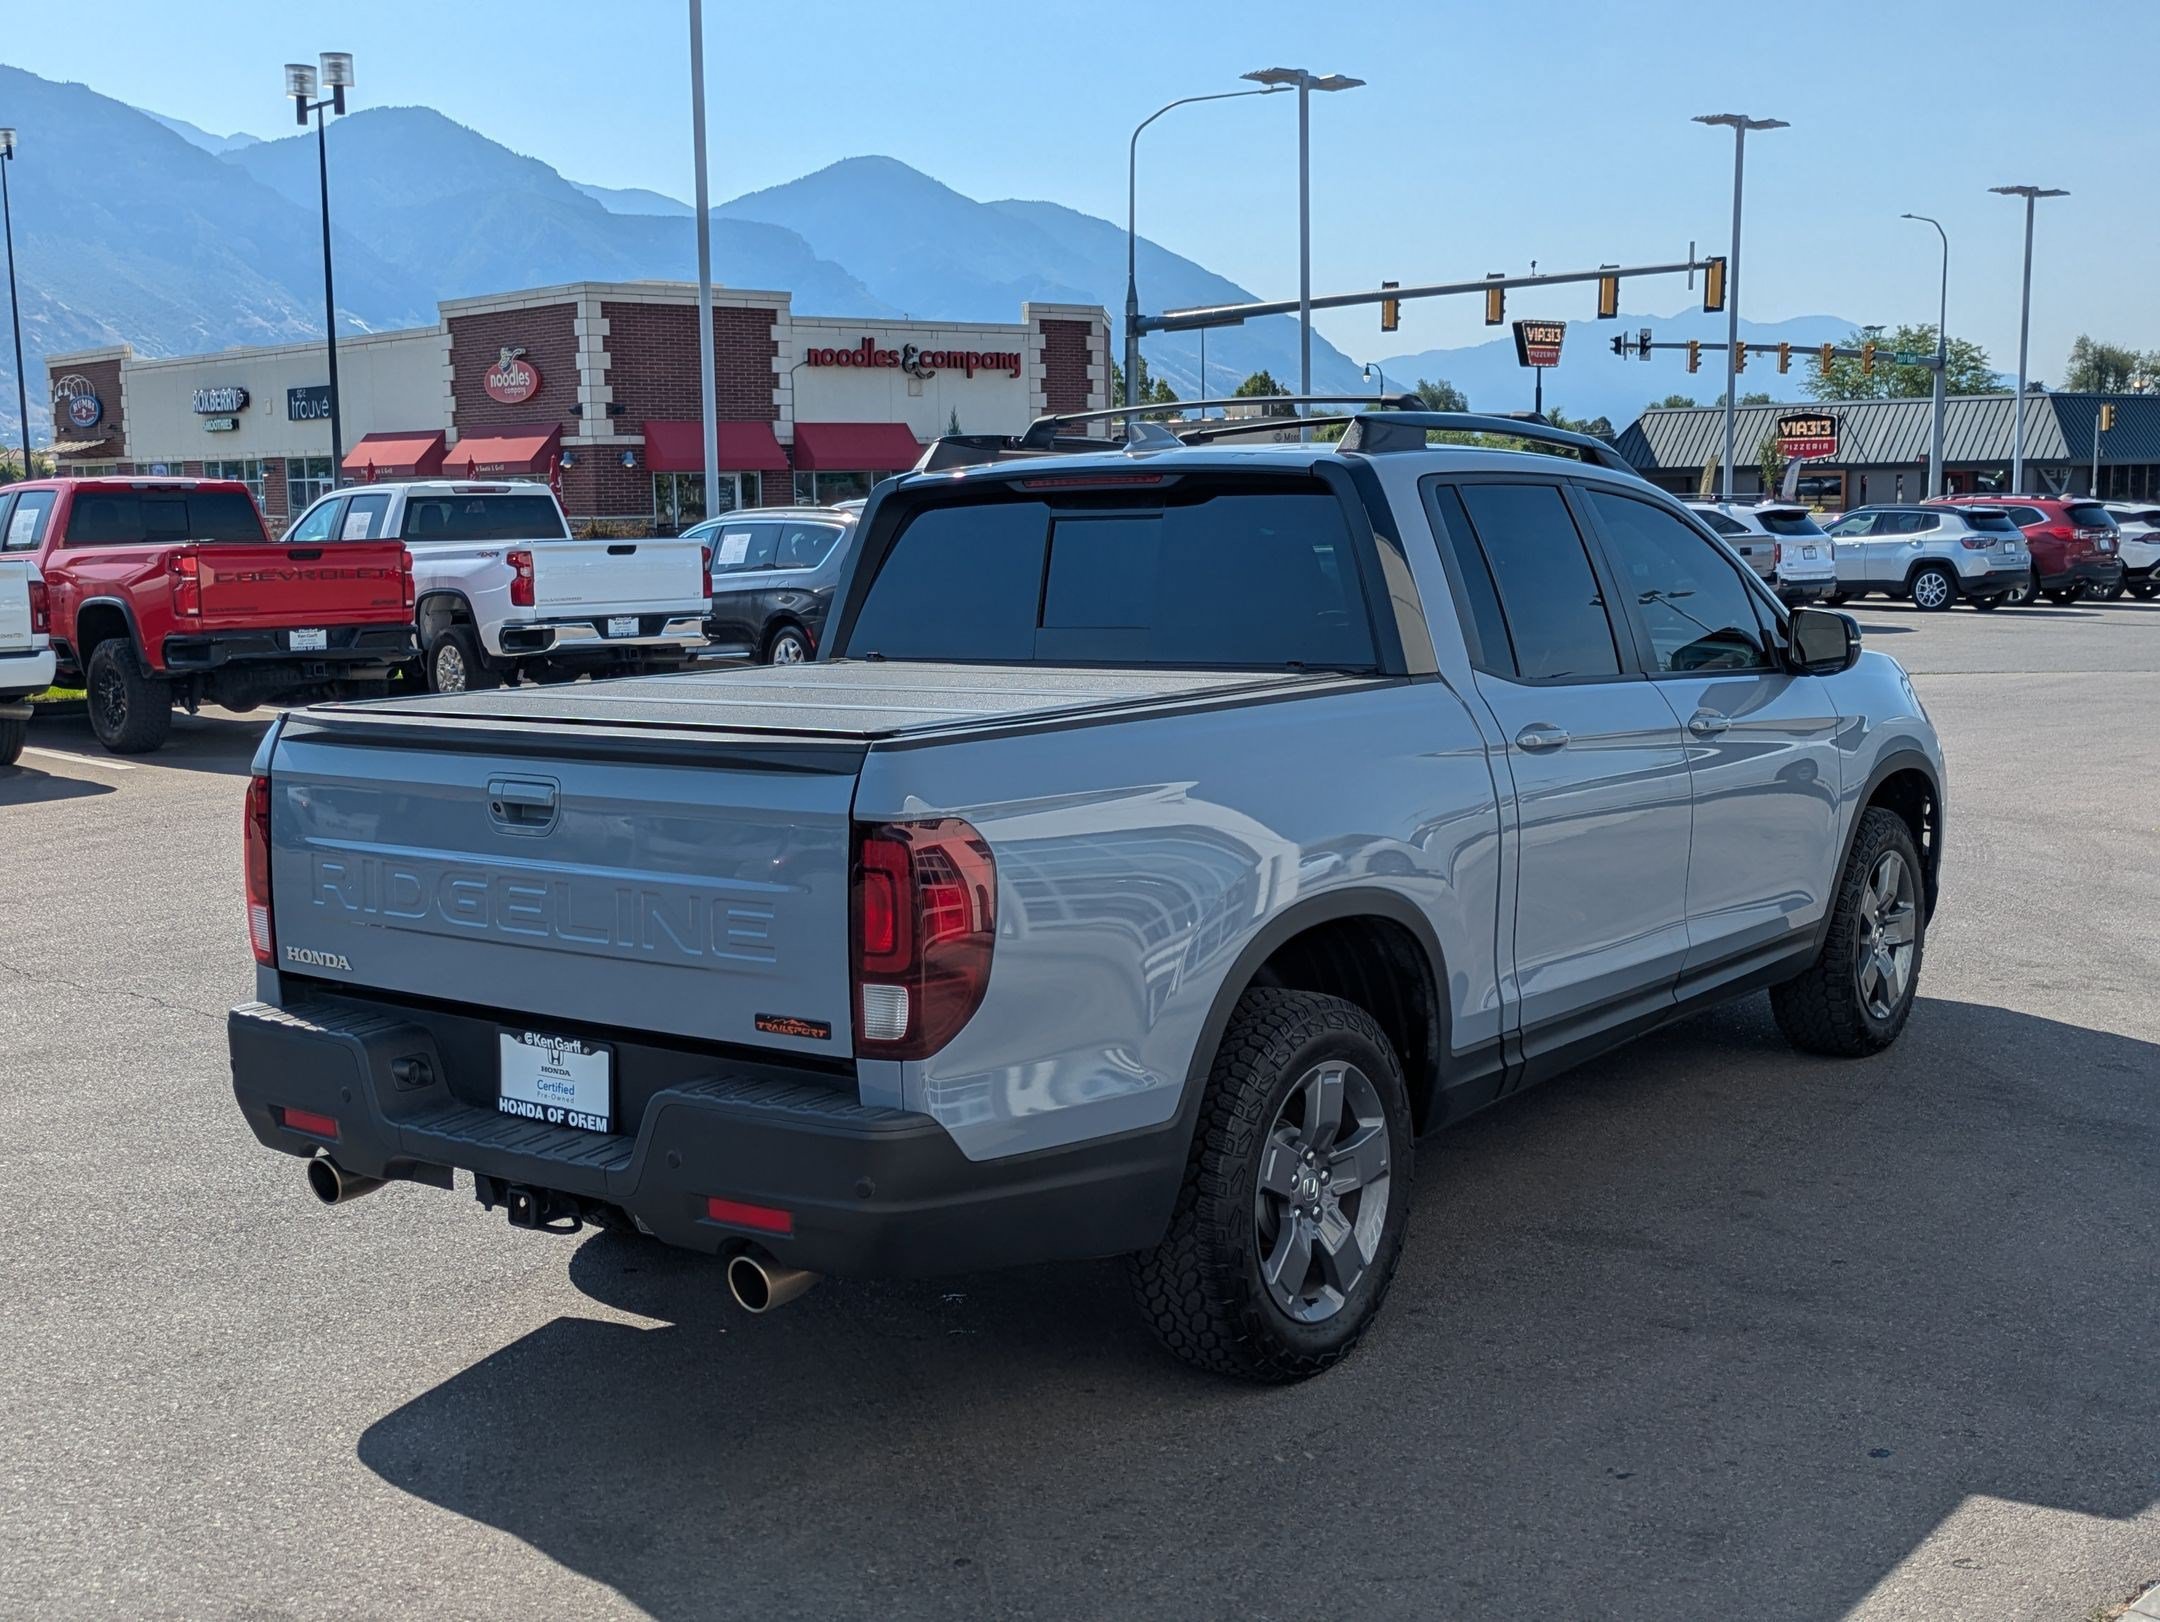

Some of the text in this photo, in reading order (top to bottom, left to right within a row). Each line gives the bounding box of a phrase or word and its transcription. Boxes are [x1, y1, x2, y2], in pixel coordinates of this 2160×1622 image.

[807, 337, 899, 367] noodles
[918, 350, 1021, 378] company
[490, 363, 530, 388] noodles
[193, 388, 237, 412] ROXBERRY
[291, 396, 329, 419] trouvé
[1783, 443, 1829, 451] PIZZERIA
[214, 567, 387, 583] CHEVROLET
[311, 857, 777, 962] RIDGELINE
[286, 946, 353, 971] HONDA
[756, 1021, 828, 1037] TRAILSPORT
[533, 1033, 581, 1054] Ken Garff
[541, 1066, 571, 1077] HONDA
[537, 1080, 575, 1096] Certified
[537, 1091, 575, 1104] Pre-Owned
[499, 1097, 607, 1133] HONDA OF OREM
